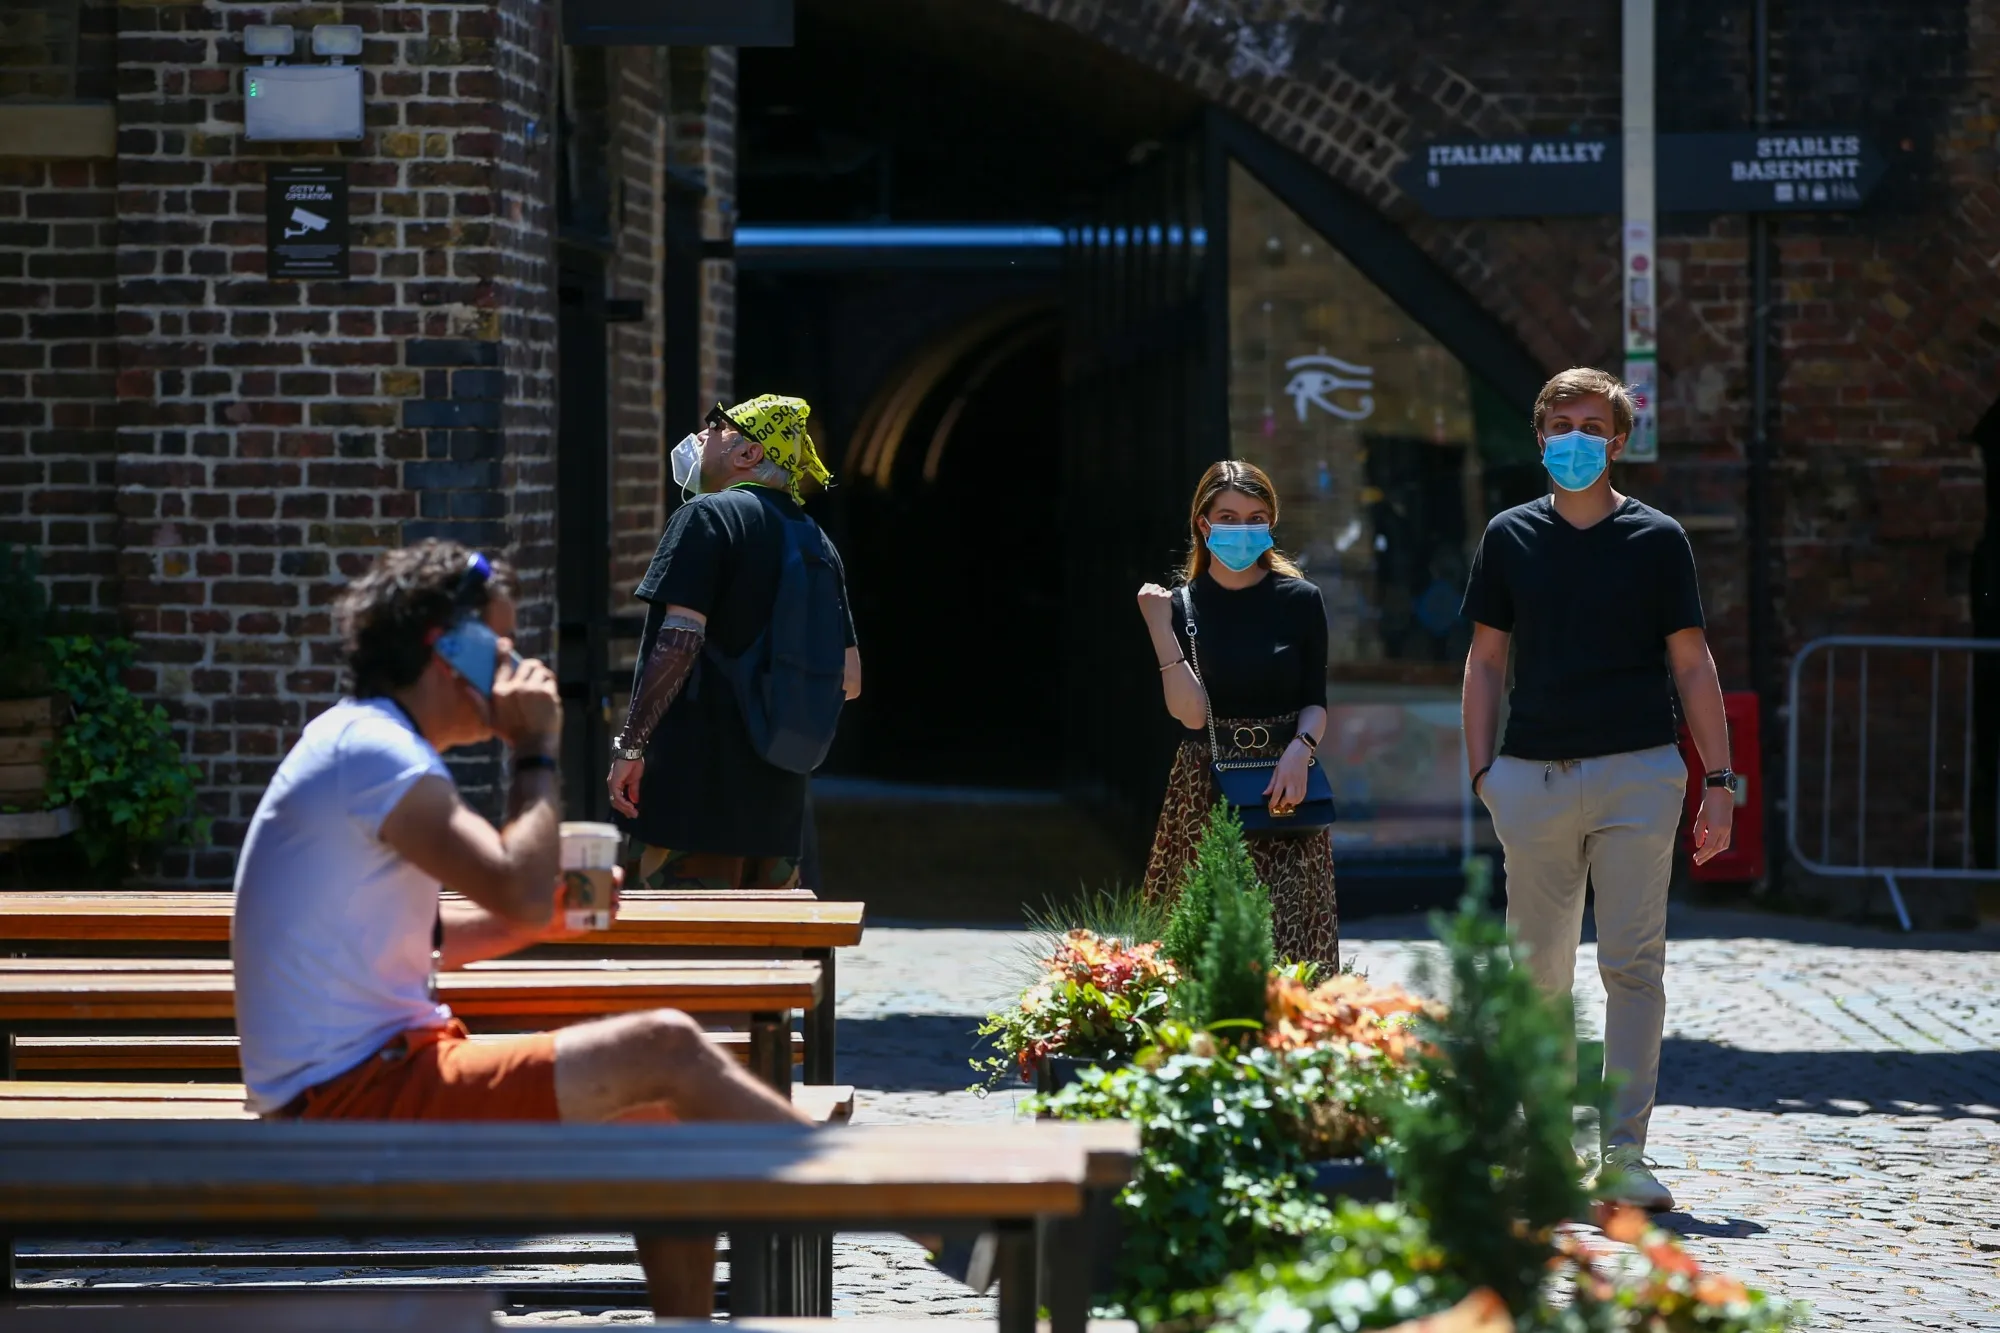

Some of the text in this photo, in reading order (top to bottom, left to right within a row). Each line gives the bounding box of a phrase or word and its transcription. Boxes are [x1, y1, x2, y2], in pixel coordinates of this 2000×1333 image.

[1428, 142, 1605, 166] ITALIAN ALLEY
[1756, 136, 1860, 157] STABLES
[1731, 158, 1859, 181] BASEMENT
[285, 192, 333, 201] OPERATION
